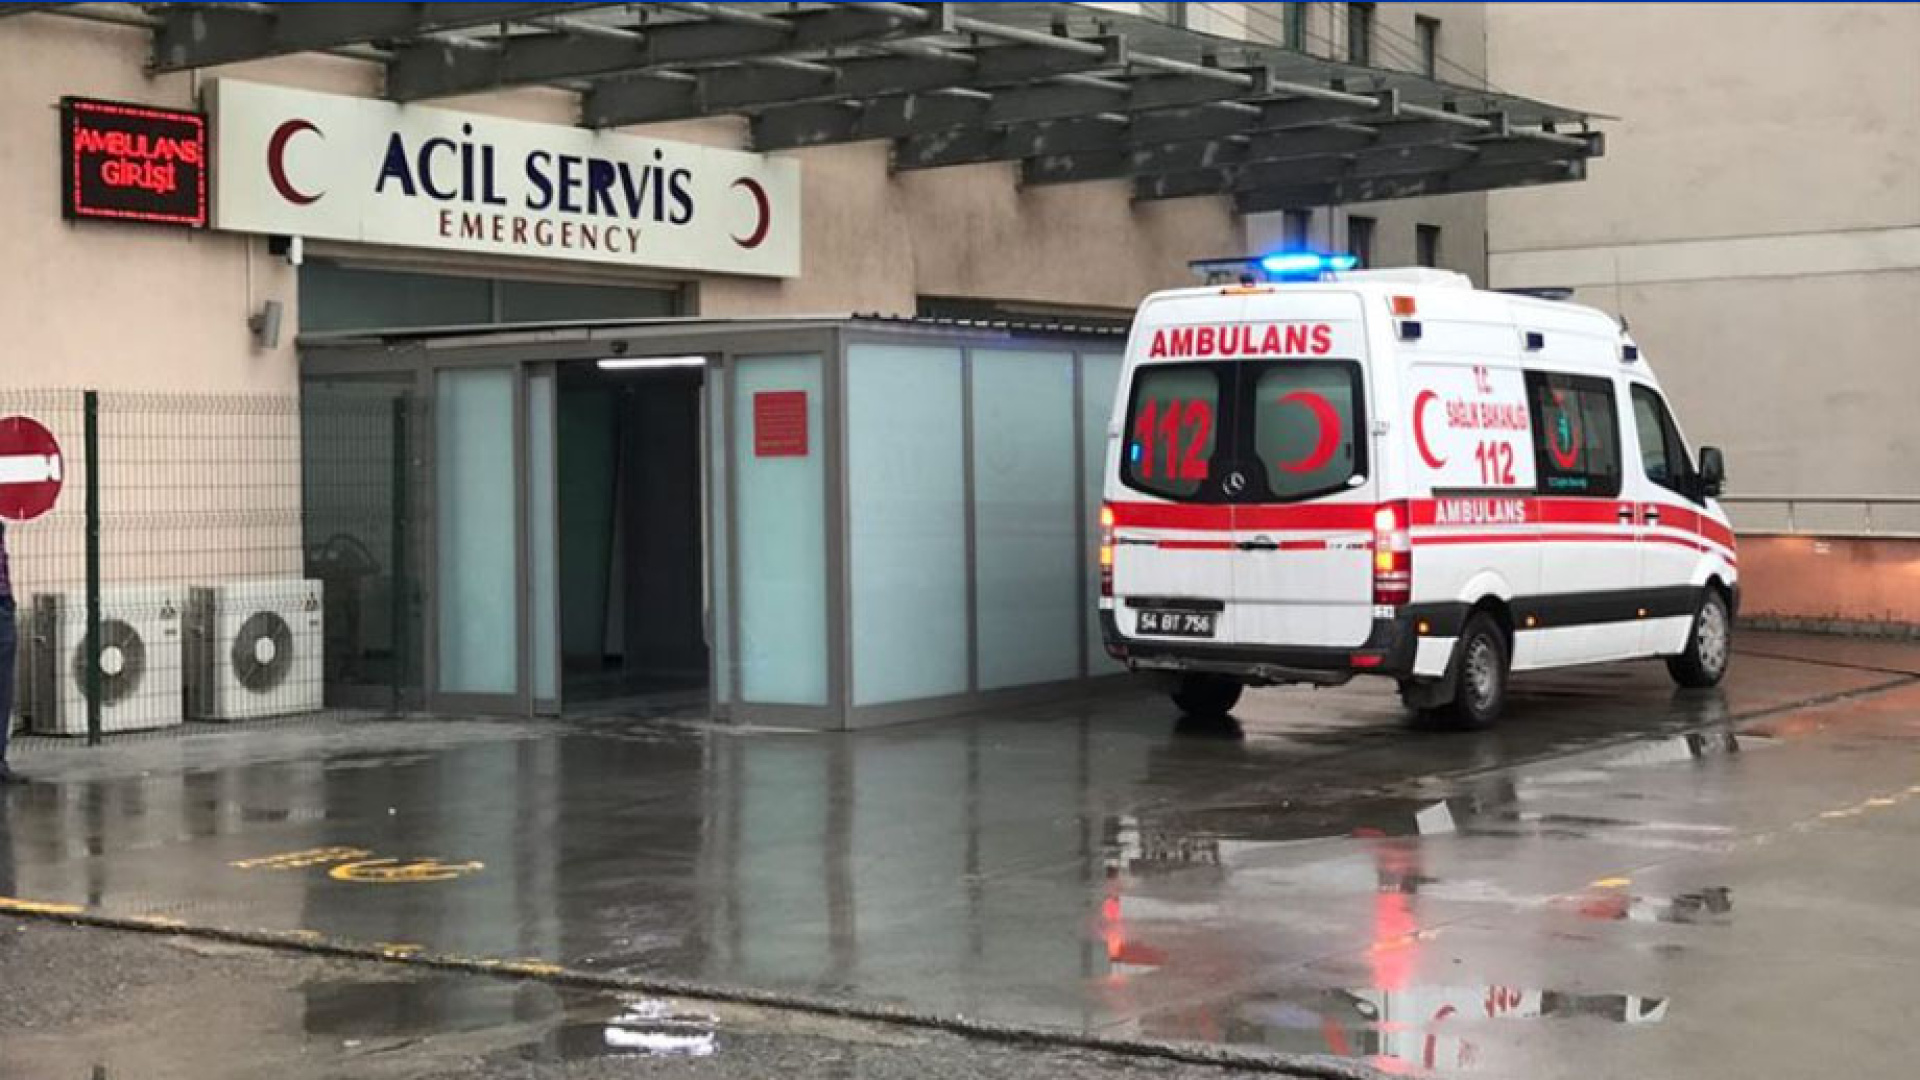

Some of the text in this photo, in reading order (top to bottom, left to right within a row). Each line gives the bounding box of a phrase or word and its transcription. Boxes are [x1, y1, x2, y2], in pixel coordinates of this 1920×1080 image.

[77, 128, 198, 163] AMBULANS
[375, 122, 694, 225] ACİL SERVİS
[439, 210, 641, 253] EMERGENCY
[1150, 324, 1332, 358] AMBULANS
[1135, 396, 1213, 480] 112
[1475, 440, 1516, 485] 112
[1436, 499, 1525, 524] AMBULANS
[1140, 613, 1157, 630] 54
